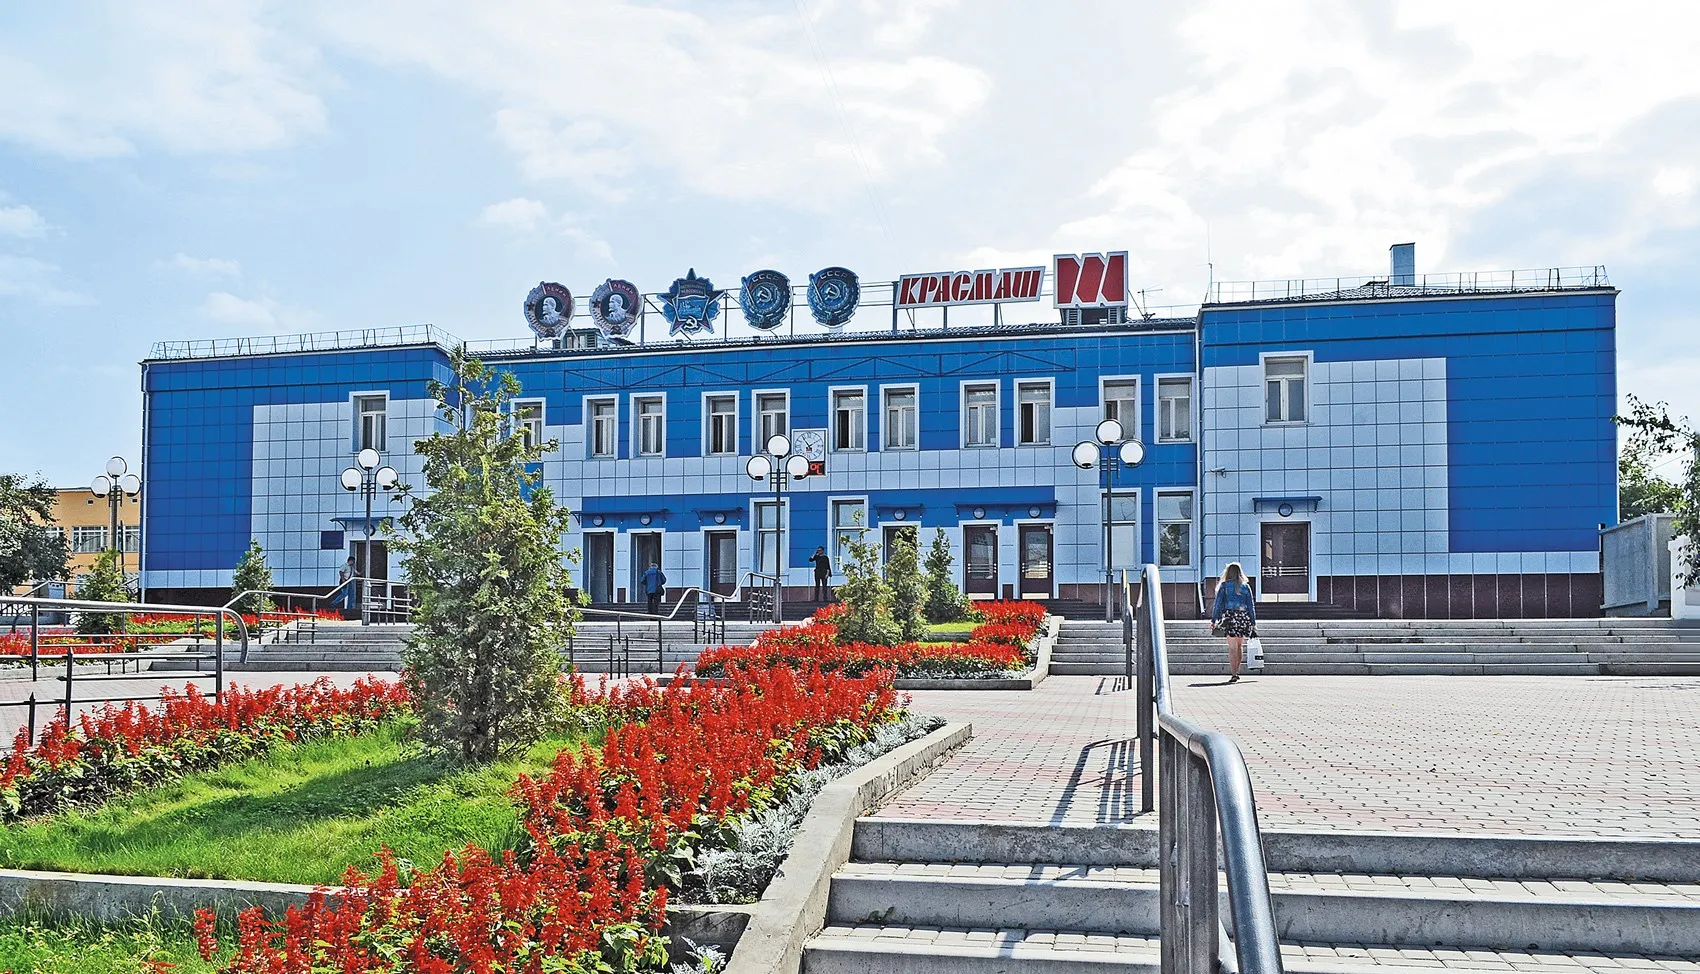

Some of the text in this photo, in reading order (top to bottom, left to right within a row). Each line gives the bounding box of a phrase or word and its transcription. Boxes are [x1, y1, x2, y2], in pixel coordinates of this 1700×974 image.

[752, 273, 779, 282] СССР
[820, 270, 848, 280] СССР
[899, 270, 1041, 304] КРАСМАШ
